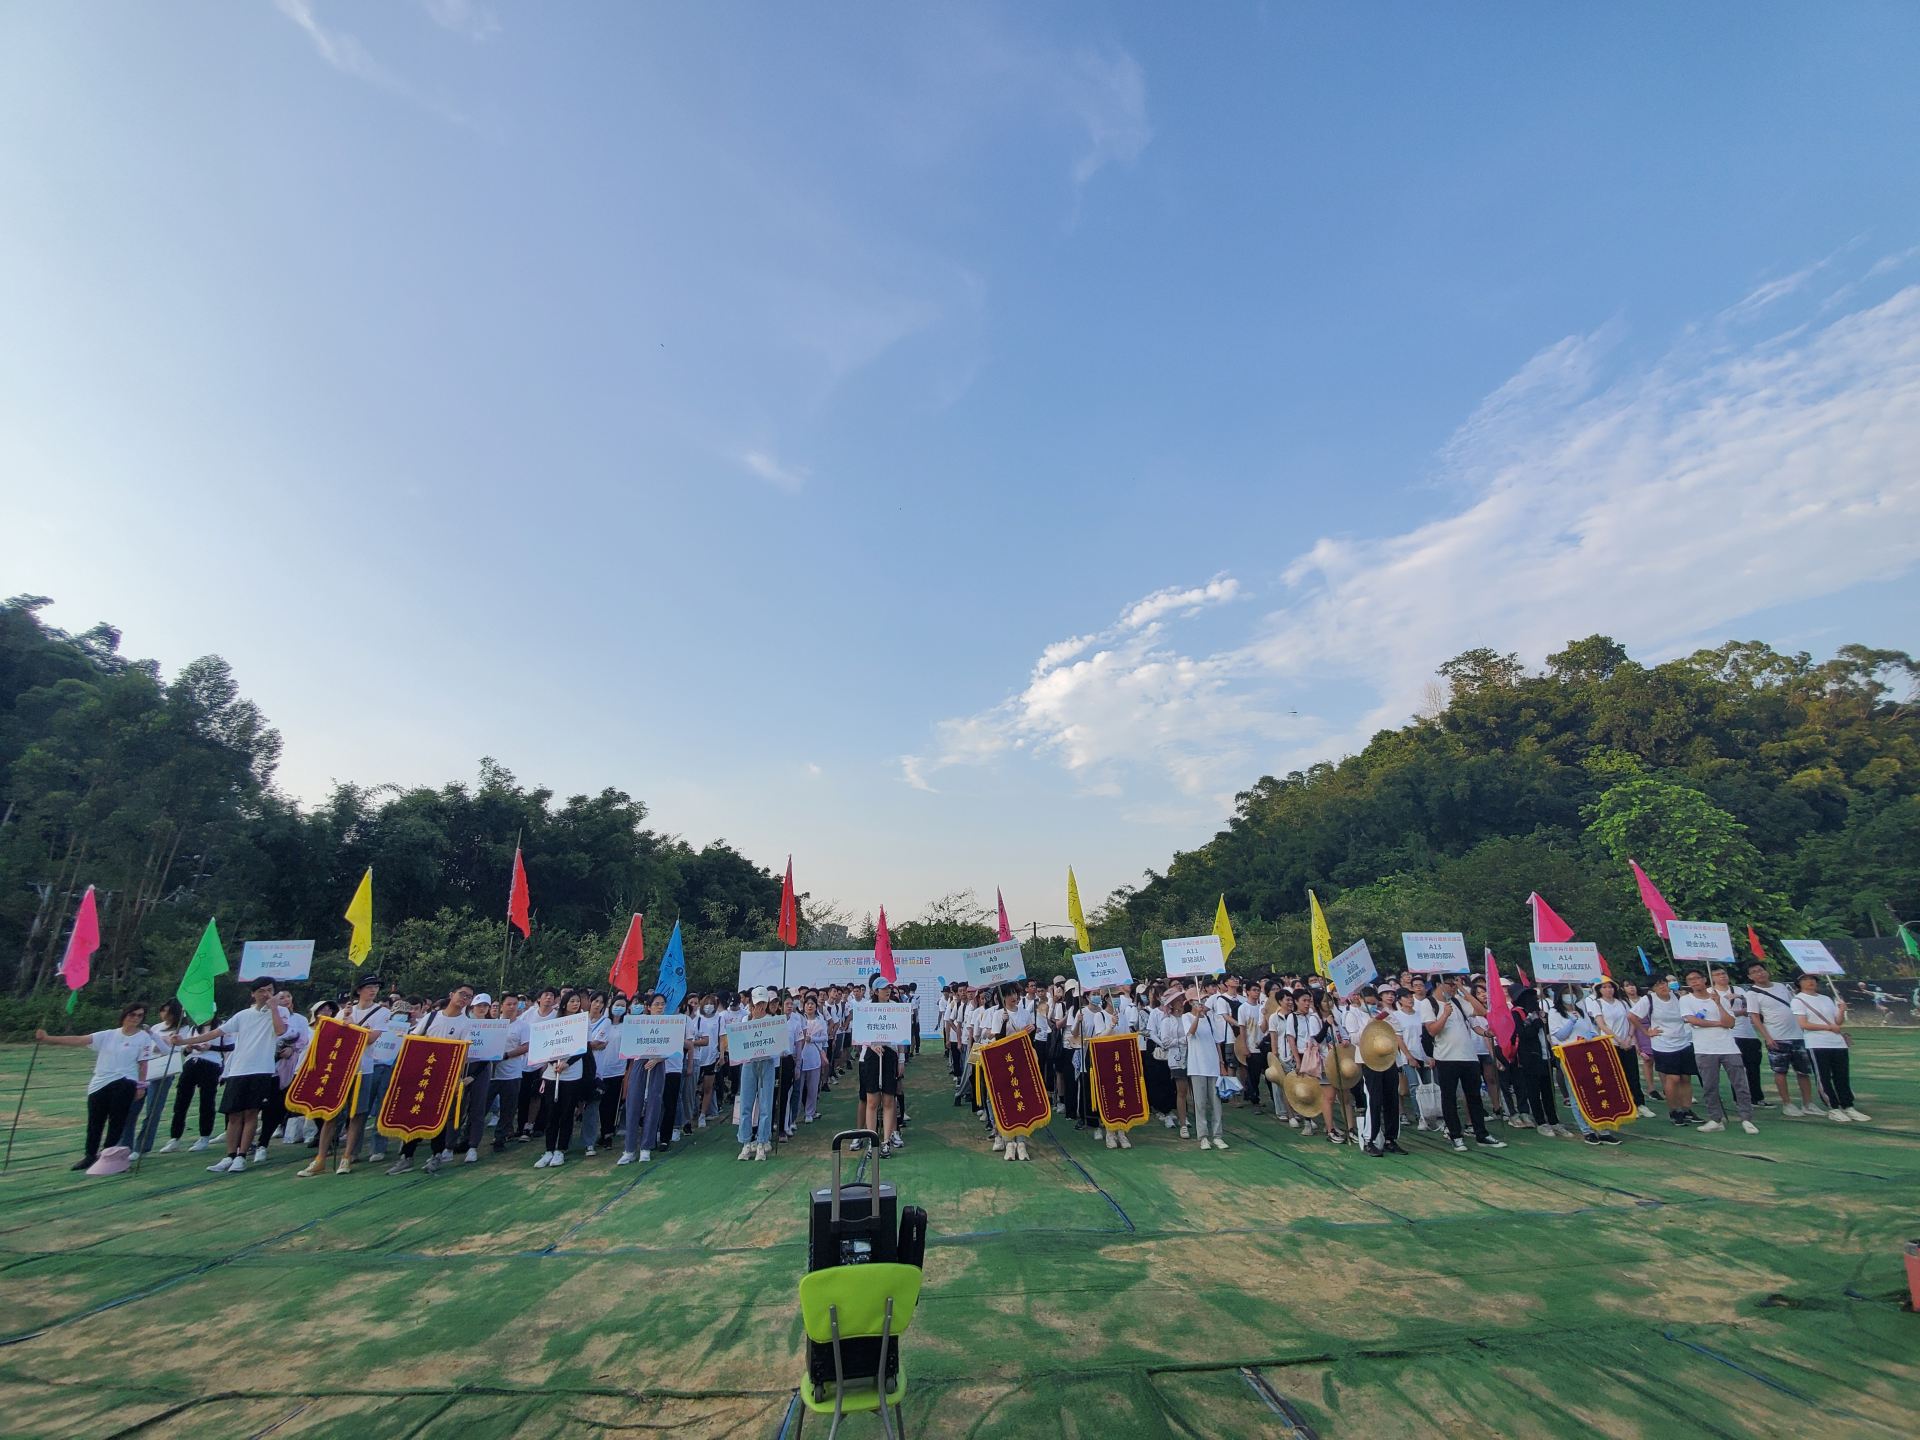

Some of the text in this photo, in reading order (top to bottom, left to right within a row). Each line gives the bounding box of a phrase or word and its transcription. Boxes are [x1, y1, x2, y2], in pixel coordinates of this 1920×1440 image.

[554, 1028, 564, 1036] A5
[753, 1030, 763, 1038] A7
[866, 1023, 898, 1031] 有我没你队
[314, 1037, 342, 1097] 勇往直前奖
[409, 1051, 437, 1115] 奋发拼搏奖
[1113, 1050, 1127, 1109] 勇往直前奖
[1585, 1051, 1610, 1110] 勇闯第一奖
